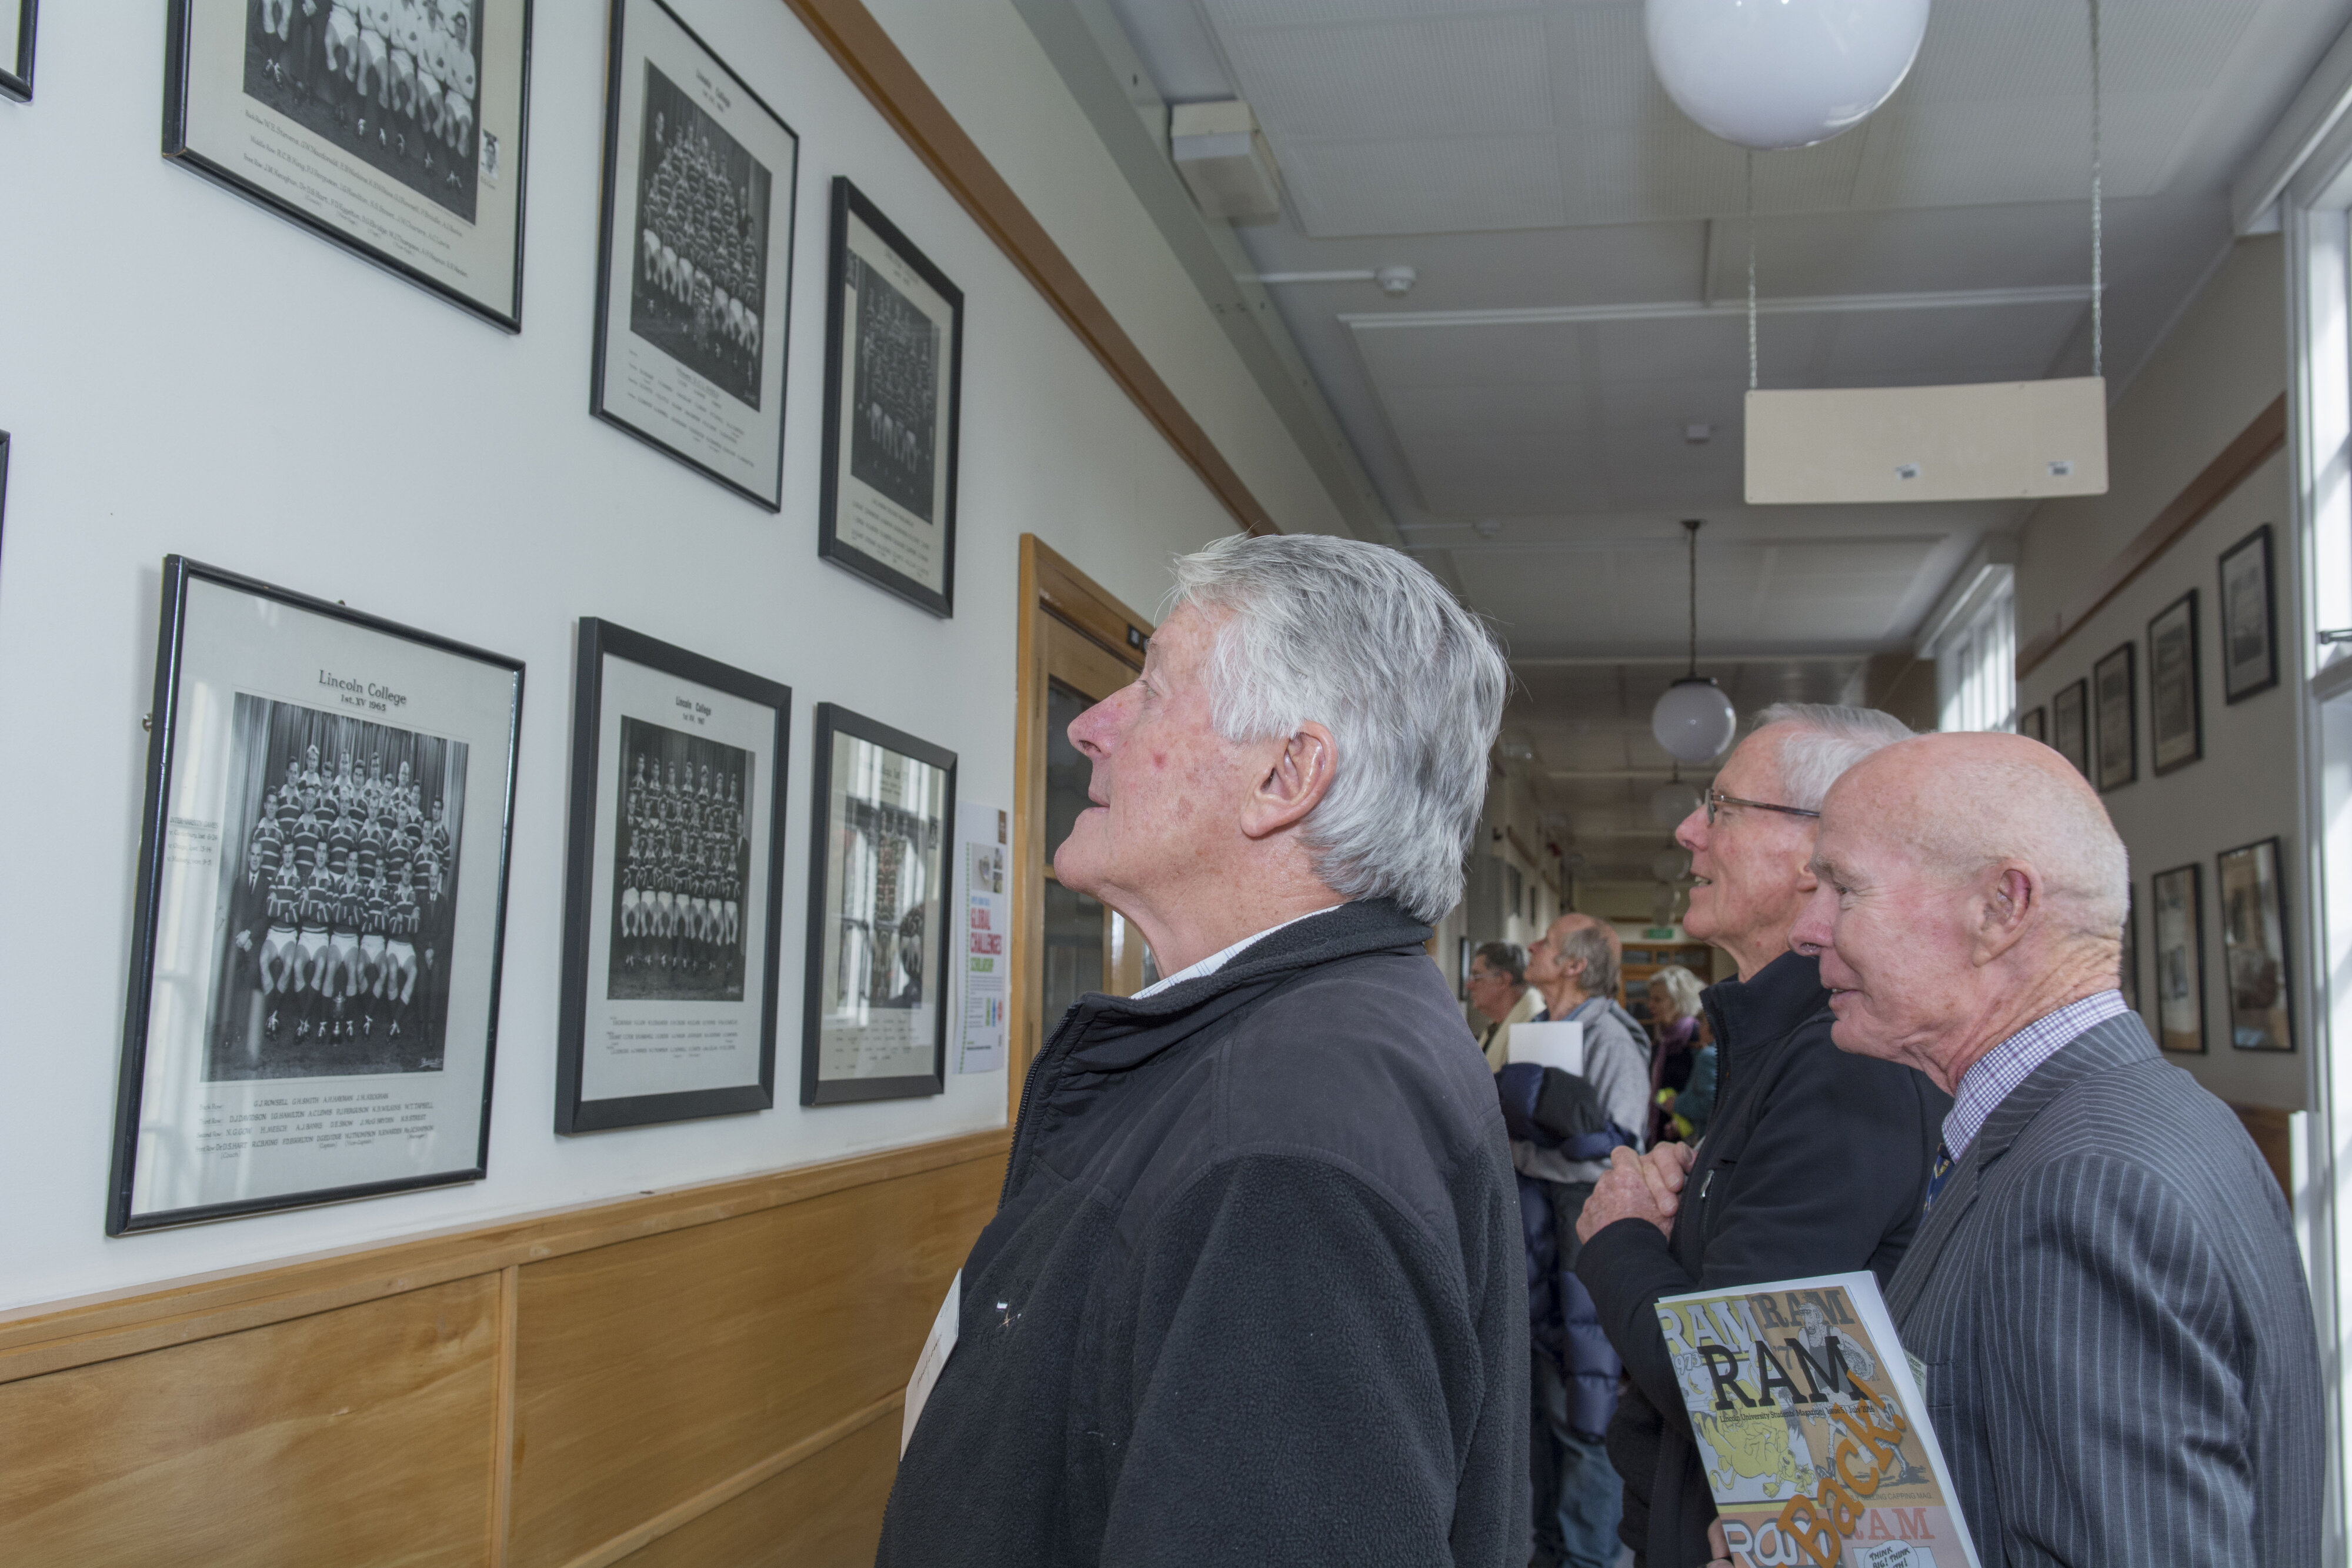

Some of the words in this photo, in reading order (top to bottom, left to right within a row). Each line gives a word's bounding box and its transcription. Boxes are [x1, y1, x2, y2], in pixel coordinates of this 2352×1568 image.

[319, 669, 363, 693] Lincoln
[368, 683, 406, 706] College
[355, 697, 366, 706] XV
[1751, 1290, 1855, 1329] RAM
[1656, 1300, 1767, 1355] RAM
[1697, 1336, 1870, 1410] RAM
[1719, 1414, 1740, 1423] Lincoln
[1741, 1412, 1770, 1422] University
[1849, 1406, 1860, 1414] July
[1862, 1405, 1875, 1413] 2016
[1776, 1369, 1906, 1568] Back!
[1887, 1493, 1916, 1501] CAPPING
[1917, 1492, 1934, 1500] MAG.
[1869, 1546, 1893, 1561] THINK
[1873, 1557, 1888, 1568] BIG!
[1889, 1547, 1910, 1562] THINK
